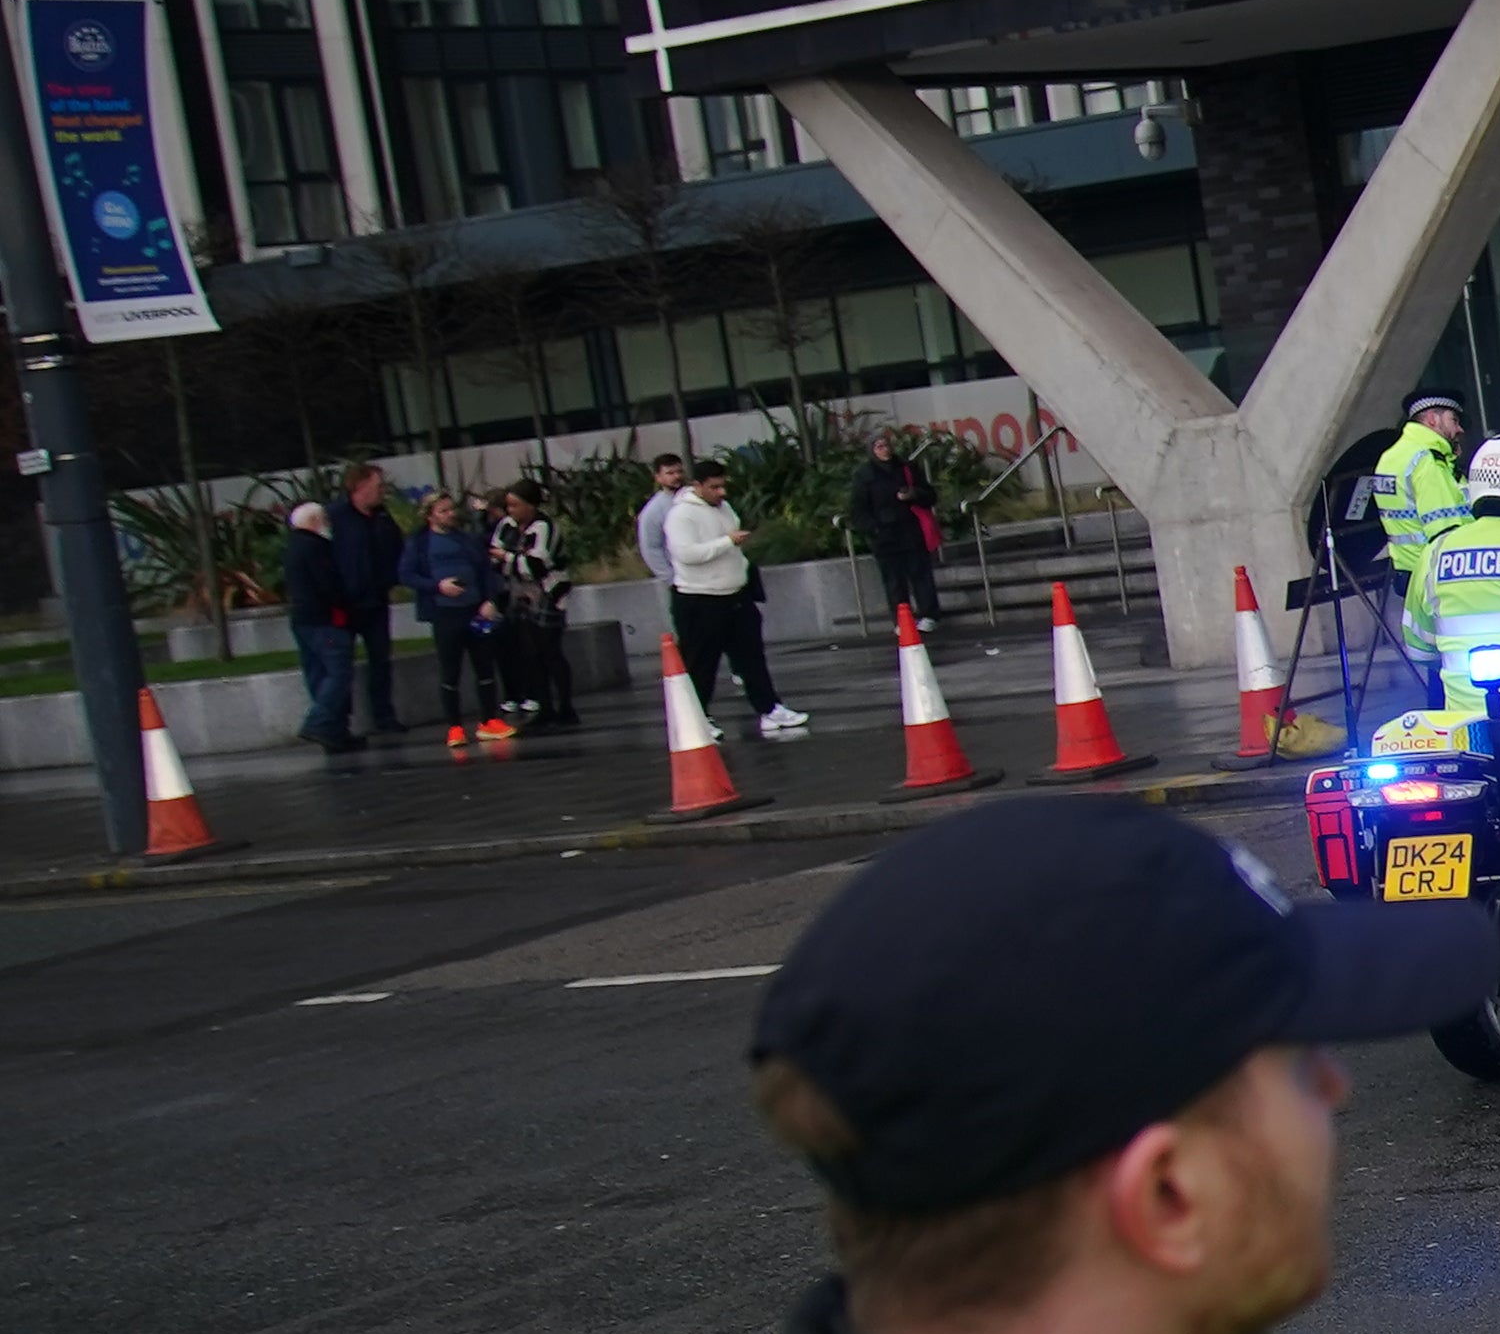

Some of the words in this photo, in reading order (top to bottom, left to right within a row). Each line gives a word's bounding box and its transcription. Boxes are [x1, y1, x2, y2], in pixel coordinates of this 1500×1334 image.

[1380, 738, 1438, 752] POLICE
[1392, 841, 1465, 868] DK24
[1399, 868, 1455, 895] CRJ
